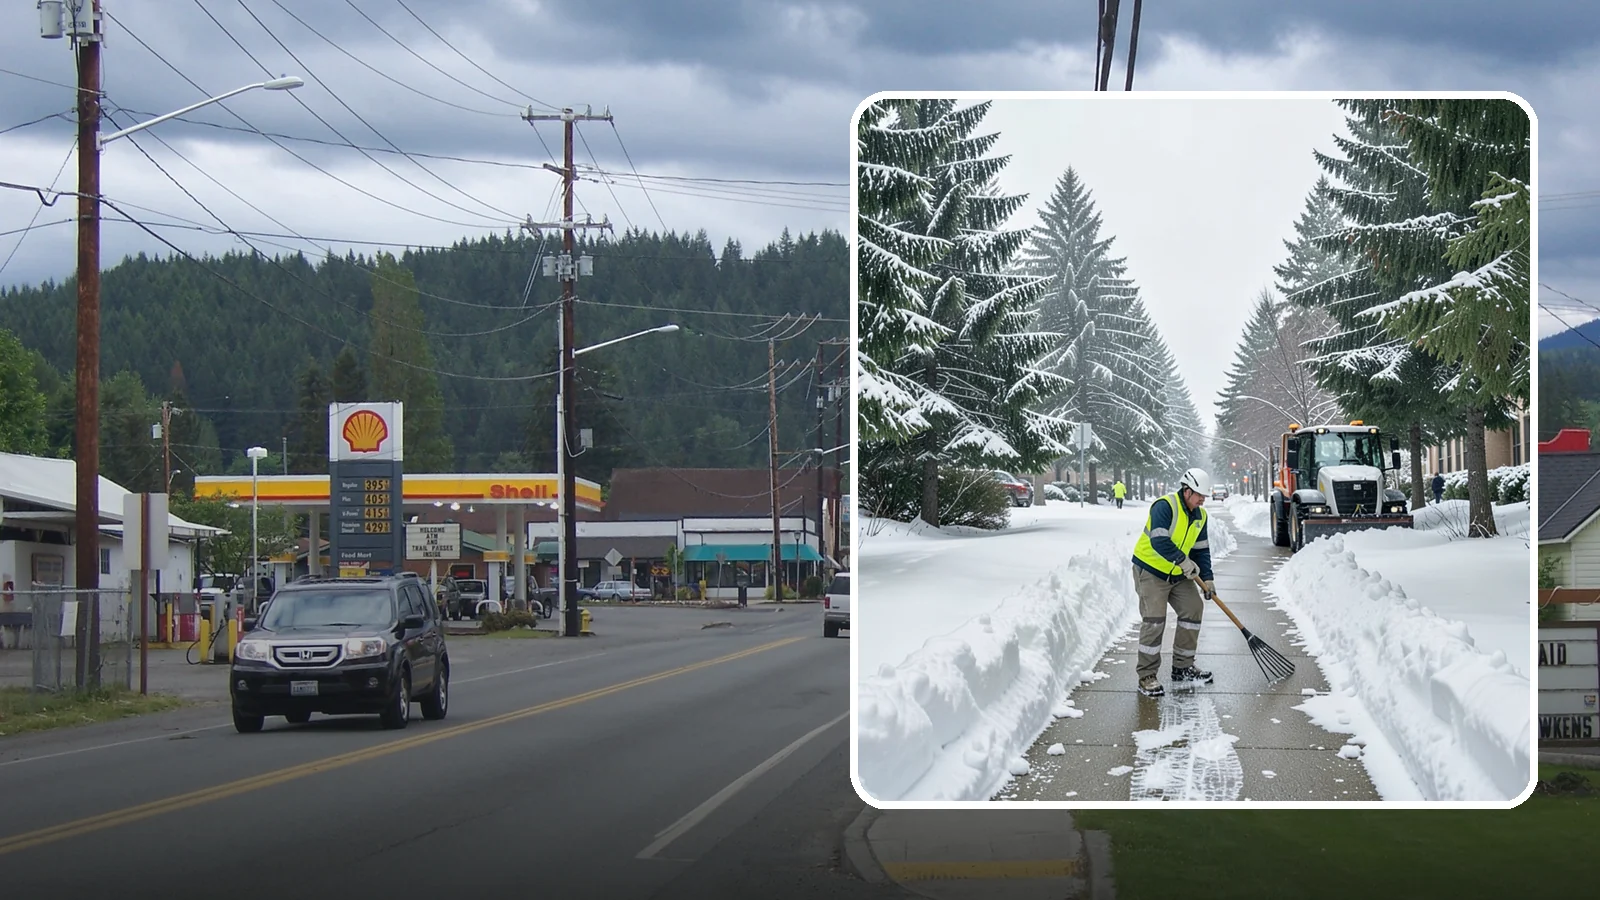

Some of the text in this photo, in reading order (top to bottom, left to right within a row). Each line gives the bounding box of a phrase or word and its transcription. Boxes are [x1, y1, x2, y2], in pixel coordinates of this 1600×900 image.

[365, 480, 384, 490] 395
[489, 484, 548, 499] Shell
[365, 494, 384, 504] 405
[365, 508, 384, 518] 415
[365, 522, 384, 532] 429
